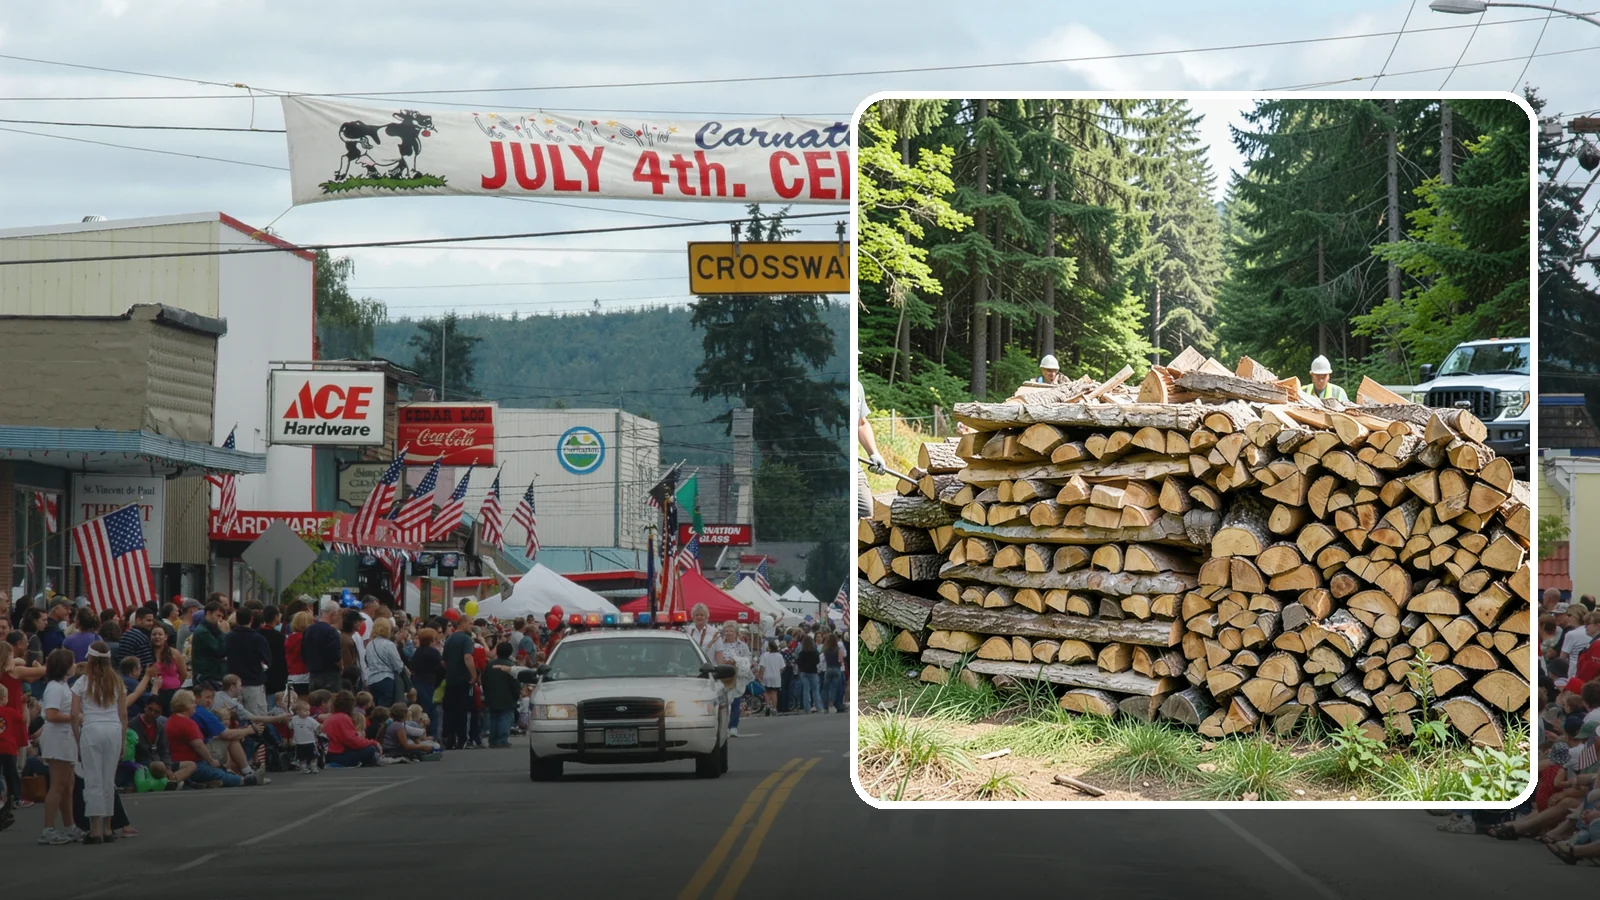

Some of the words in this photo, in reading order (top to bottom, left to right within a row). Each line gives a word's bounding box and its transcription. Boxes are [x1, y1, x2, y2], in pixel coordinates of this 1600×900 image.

[695, 121, 850, 150] Carnat
[481, 141, 605, 192] JULY
[632, 150, 746, 197] 4th.
[697, 254, 850, 280] CROSSWA
[282, 380, 373, 420] ACE
[405, 409, 452, 422] CEDAR
[284, 421, 370, 436] Hardware
[416, 428, 476, 446] Coca-Cola
[353, 467, 385, 479] Simpl
[83, 484, 94, 494] St.
[96, 485, 124, 495] Vincent
[126, 486, 135, 495] de
[138, 486, 155, 495] Paul
[688, 526, 741, 535] CRNATION
[699, 535, 730, 543] GLASS
